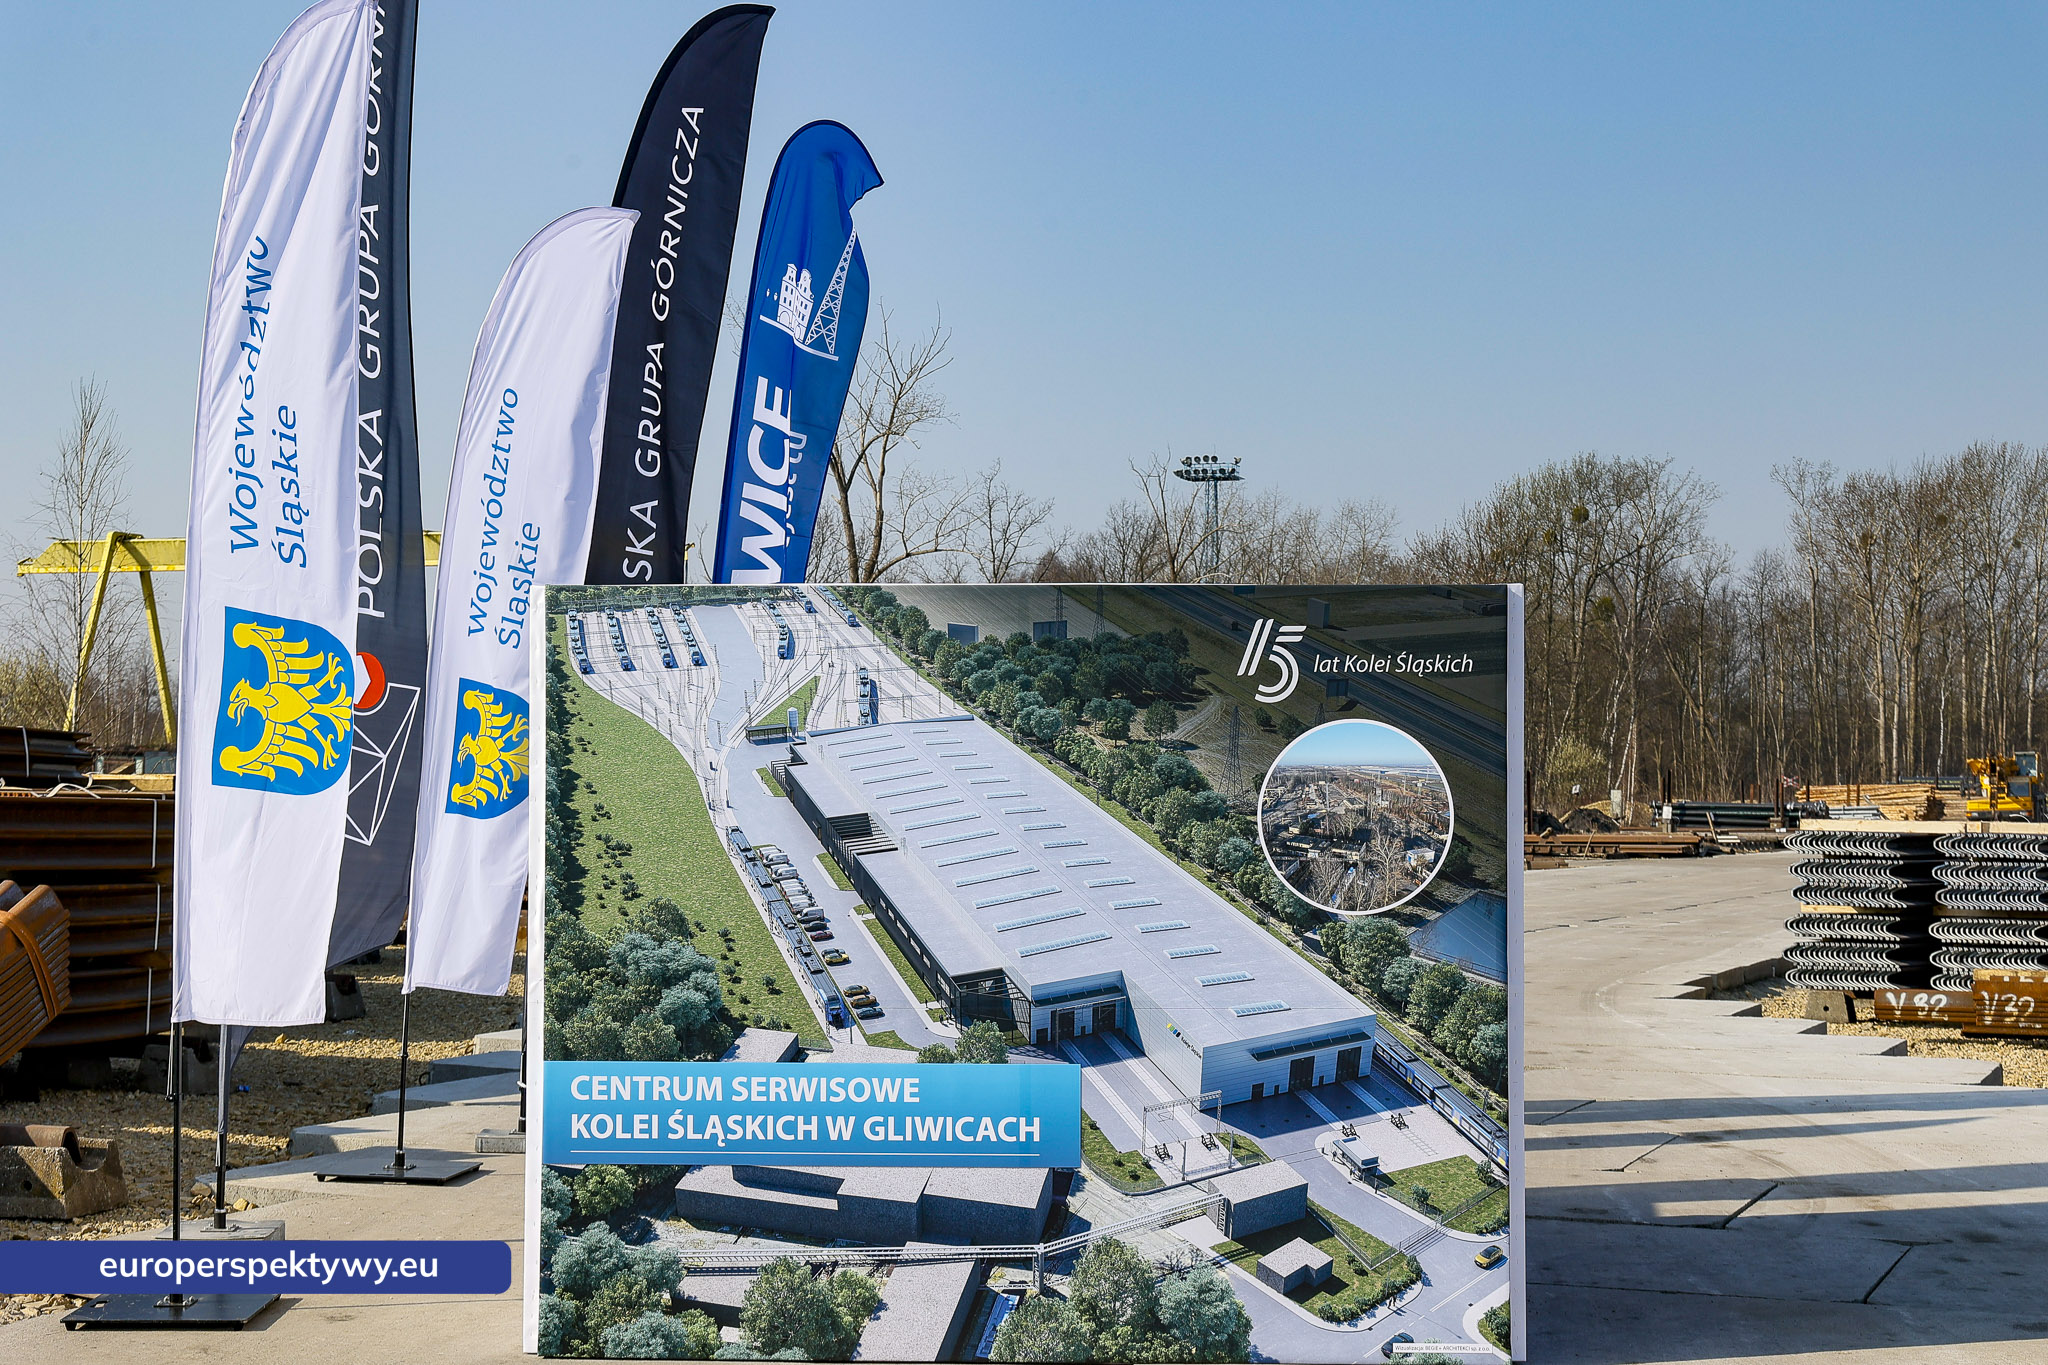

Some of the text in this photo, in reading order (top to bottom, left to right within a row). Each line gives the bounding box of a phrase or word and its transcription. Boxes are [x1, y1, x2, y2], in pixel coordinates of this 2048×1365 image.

[359, 204, 382, 379] GRUPA
[635, 342, 665, 478] GRUPA
[650, 106, 704, 322] GÓRNICZA
[229, 235, 272, 554] Województwo
[272, 404, 307, 569] Śląskie
[358, 408, 385, 618] POLSKA
[468, 387, 519, 638] Województwo
[493, 522, 541, 650] Śląskie
[1237, 618, 1474, 704] 15 lat Kolei Śląskich
[570, 1075, 920, 1103] CENTRUM SERWISOWE
[571, 1109, 1041, 1147] KOLEI ŚLĄSKICH W GLIWICACH
